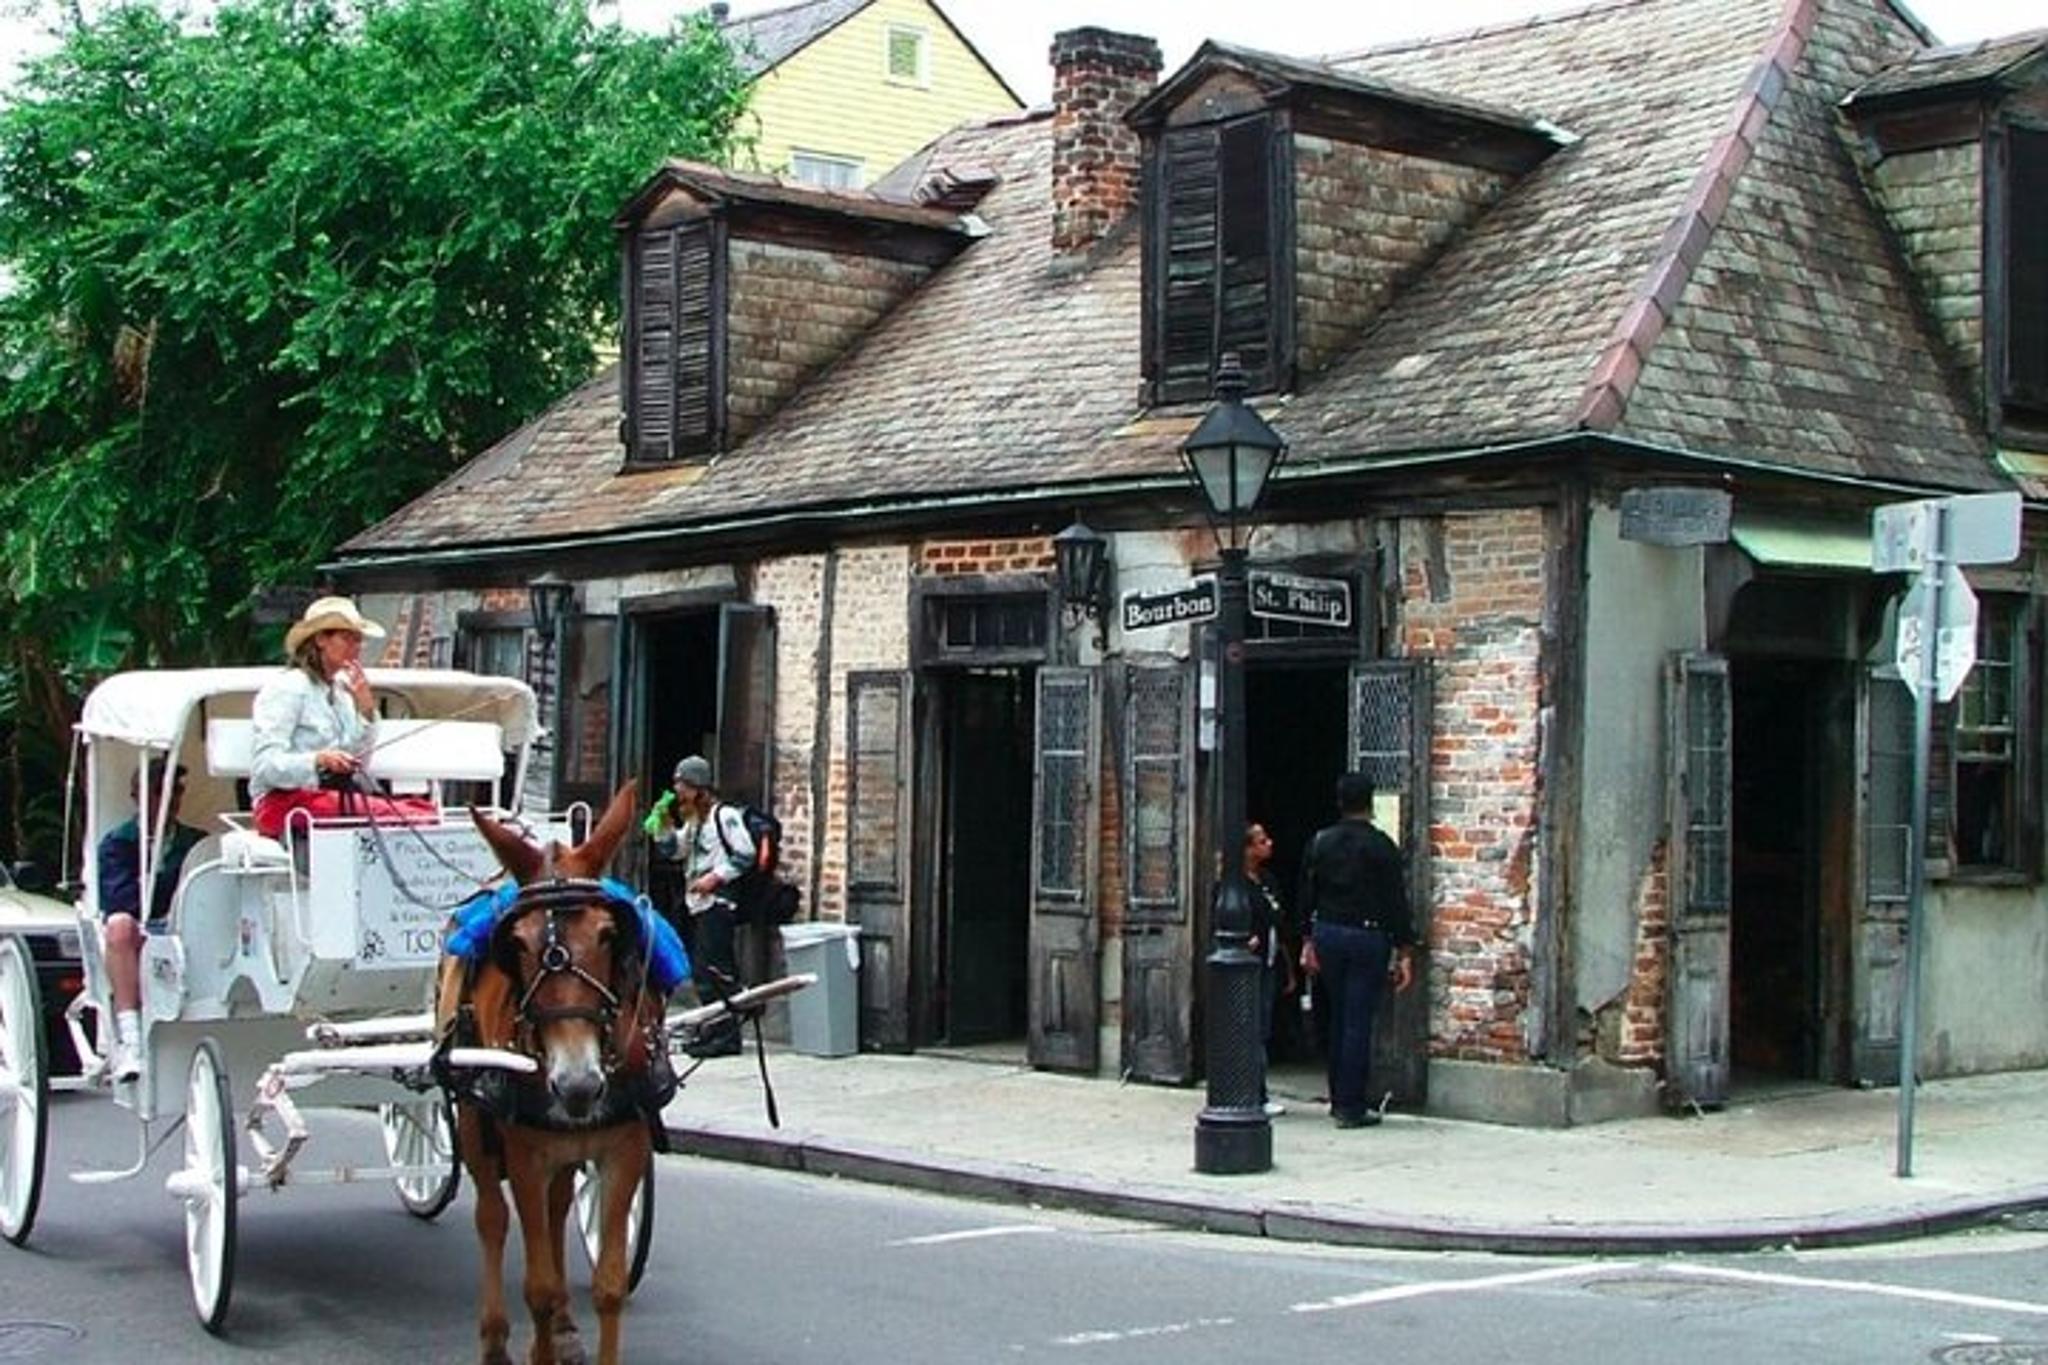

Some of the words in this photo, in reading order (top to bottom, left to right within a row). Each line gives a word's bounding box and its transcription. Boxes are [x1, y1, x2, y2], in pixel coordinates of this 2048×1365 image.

[1127, 596, 1212, 626] Bourbon
[1256, 585, 1280, 607] St.
[1287, 589, 1341, 620] Philip
